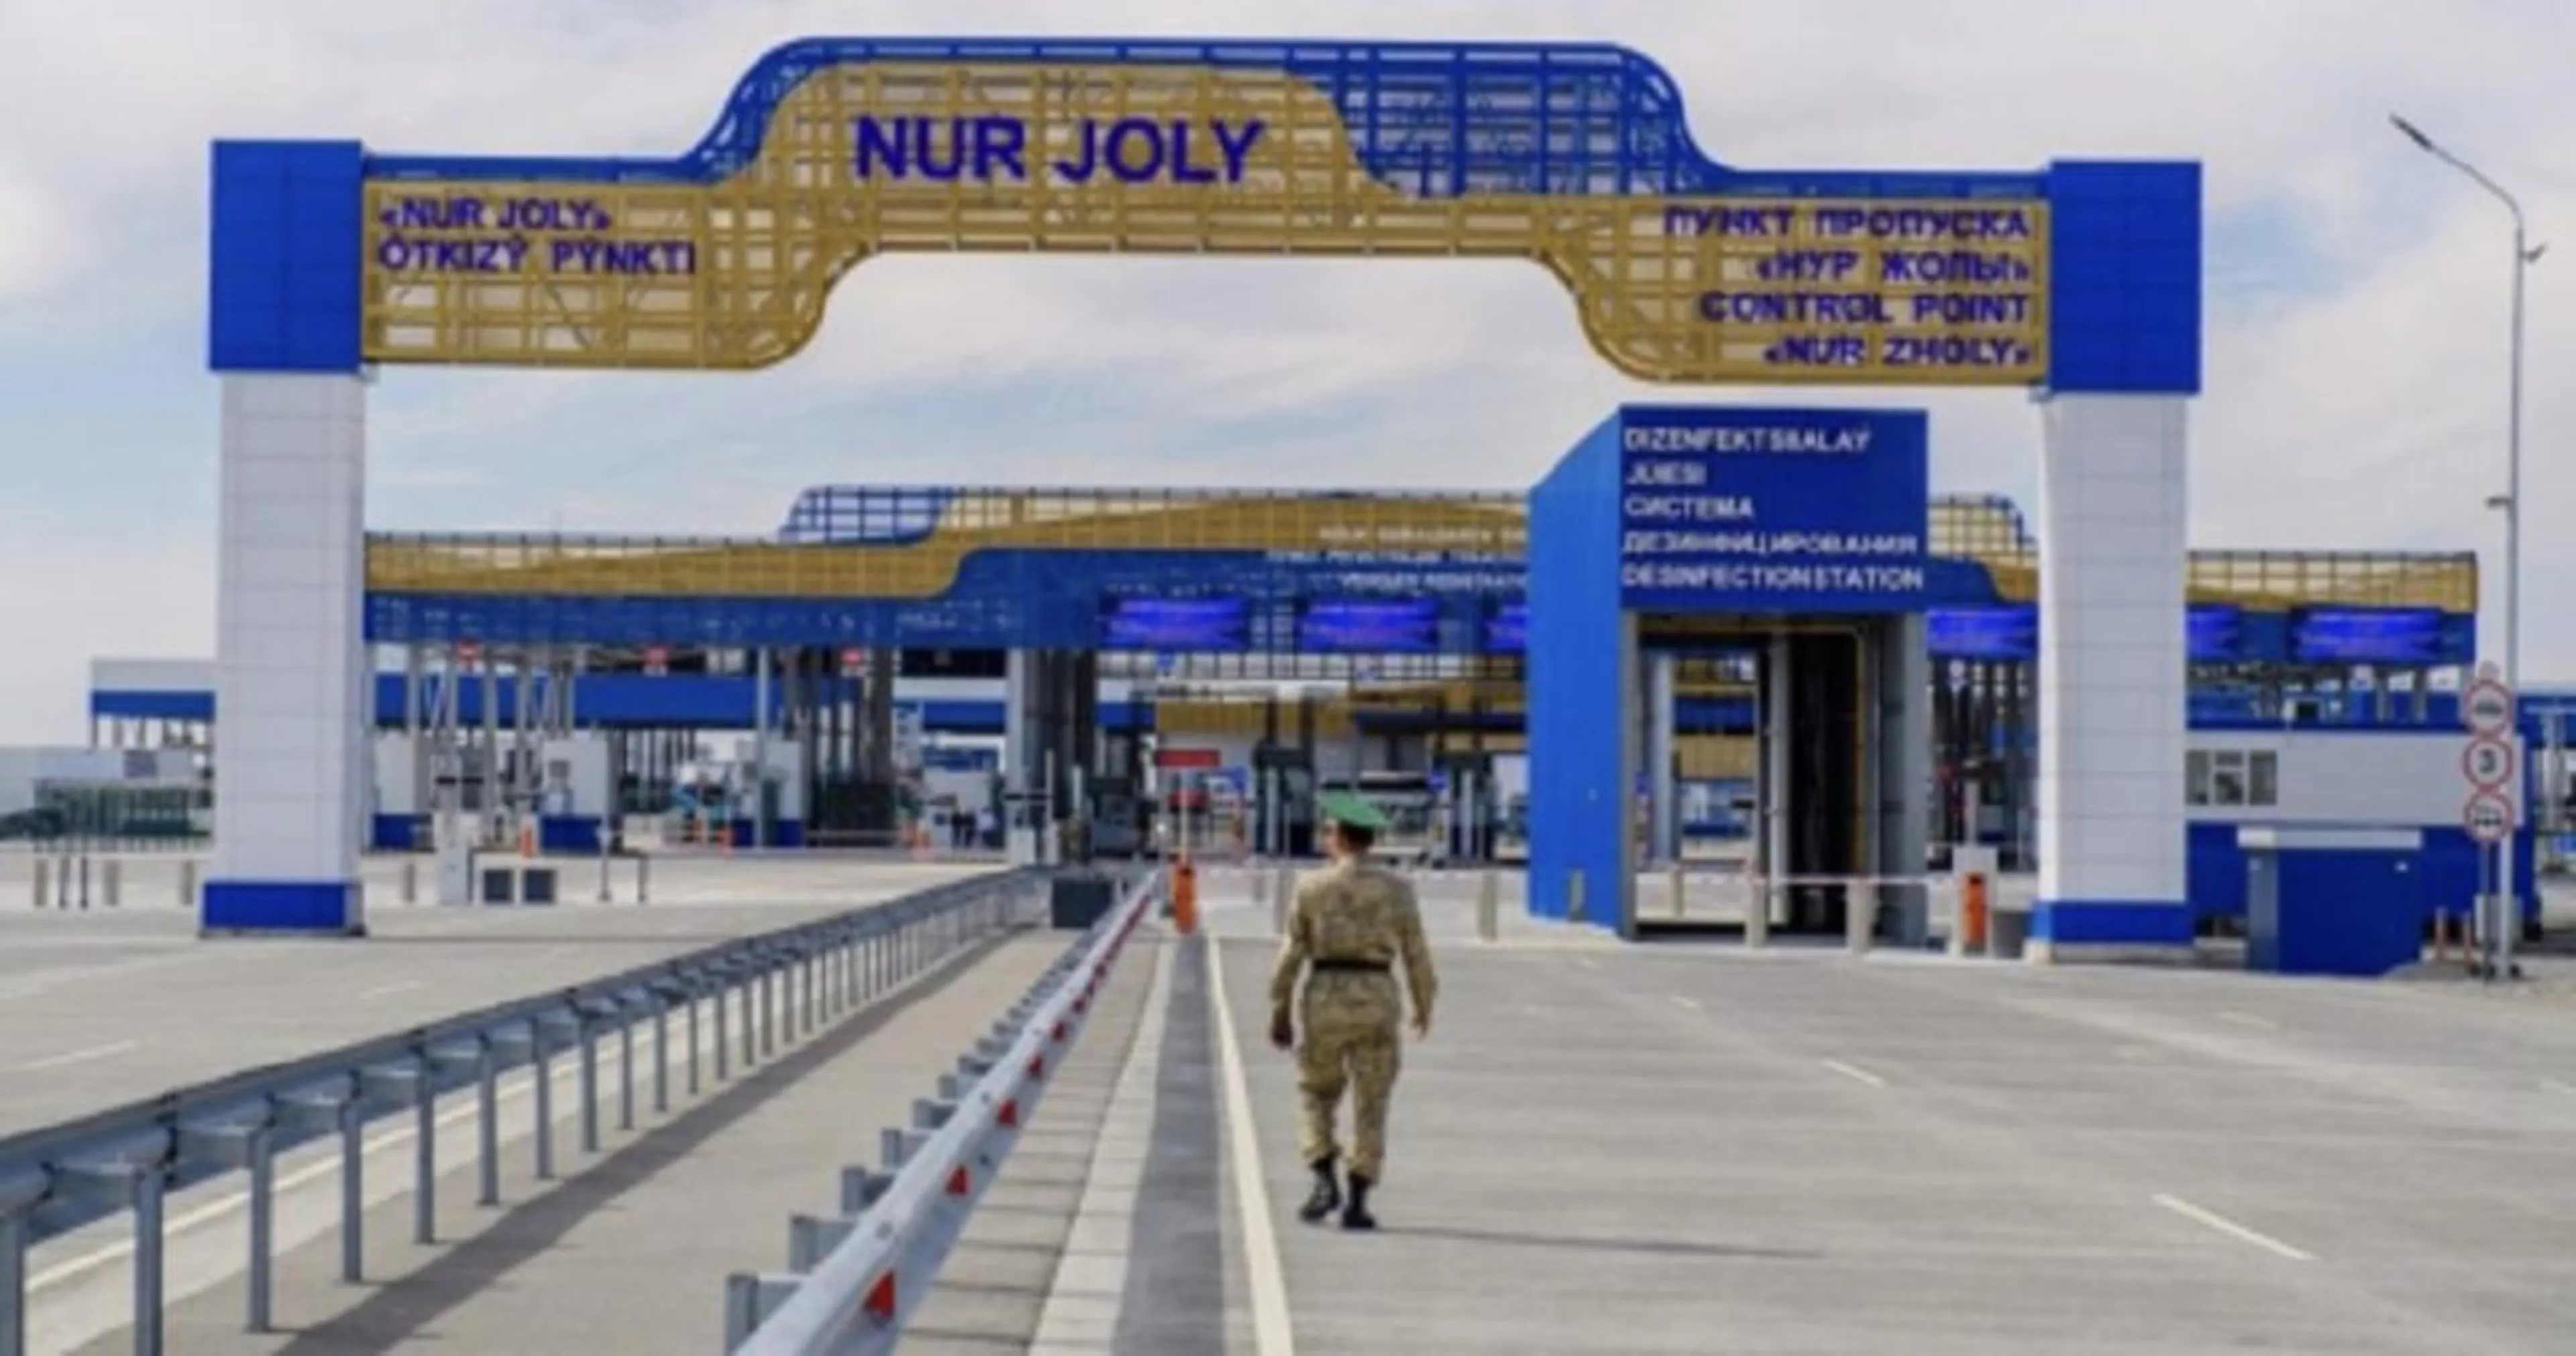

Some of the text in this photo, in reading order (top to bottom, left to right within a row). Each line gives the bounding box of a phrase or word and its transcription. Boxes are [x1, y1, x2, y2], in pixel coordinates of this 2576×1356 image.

[855, 115, 1267, 183] NUR JOLY
[1664, 207, 2029, 237] ПУНКТ ПРОПУСКА
[1699, 291, 2030, 323] CONTROL POINT
[1624, 495, 1754, 520] СИСТЕМА
[1813, 566, 1925, 591] STATION
